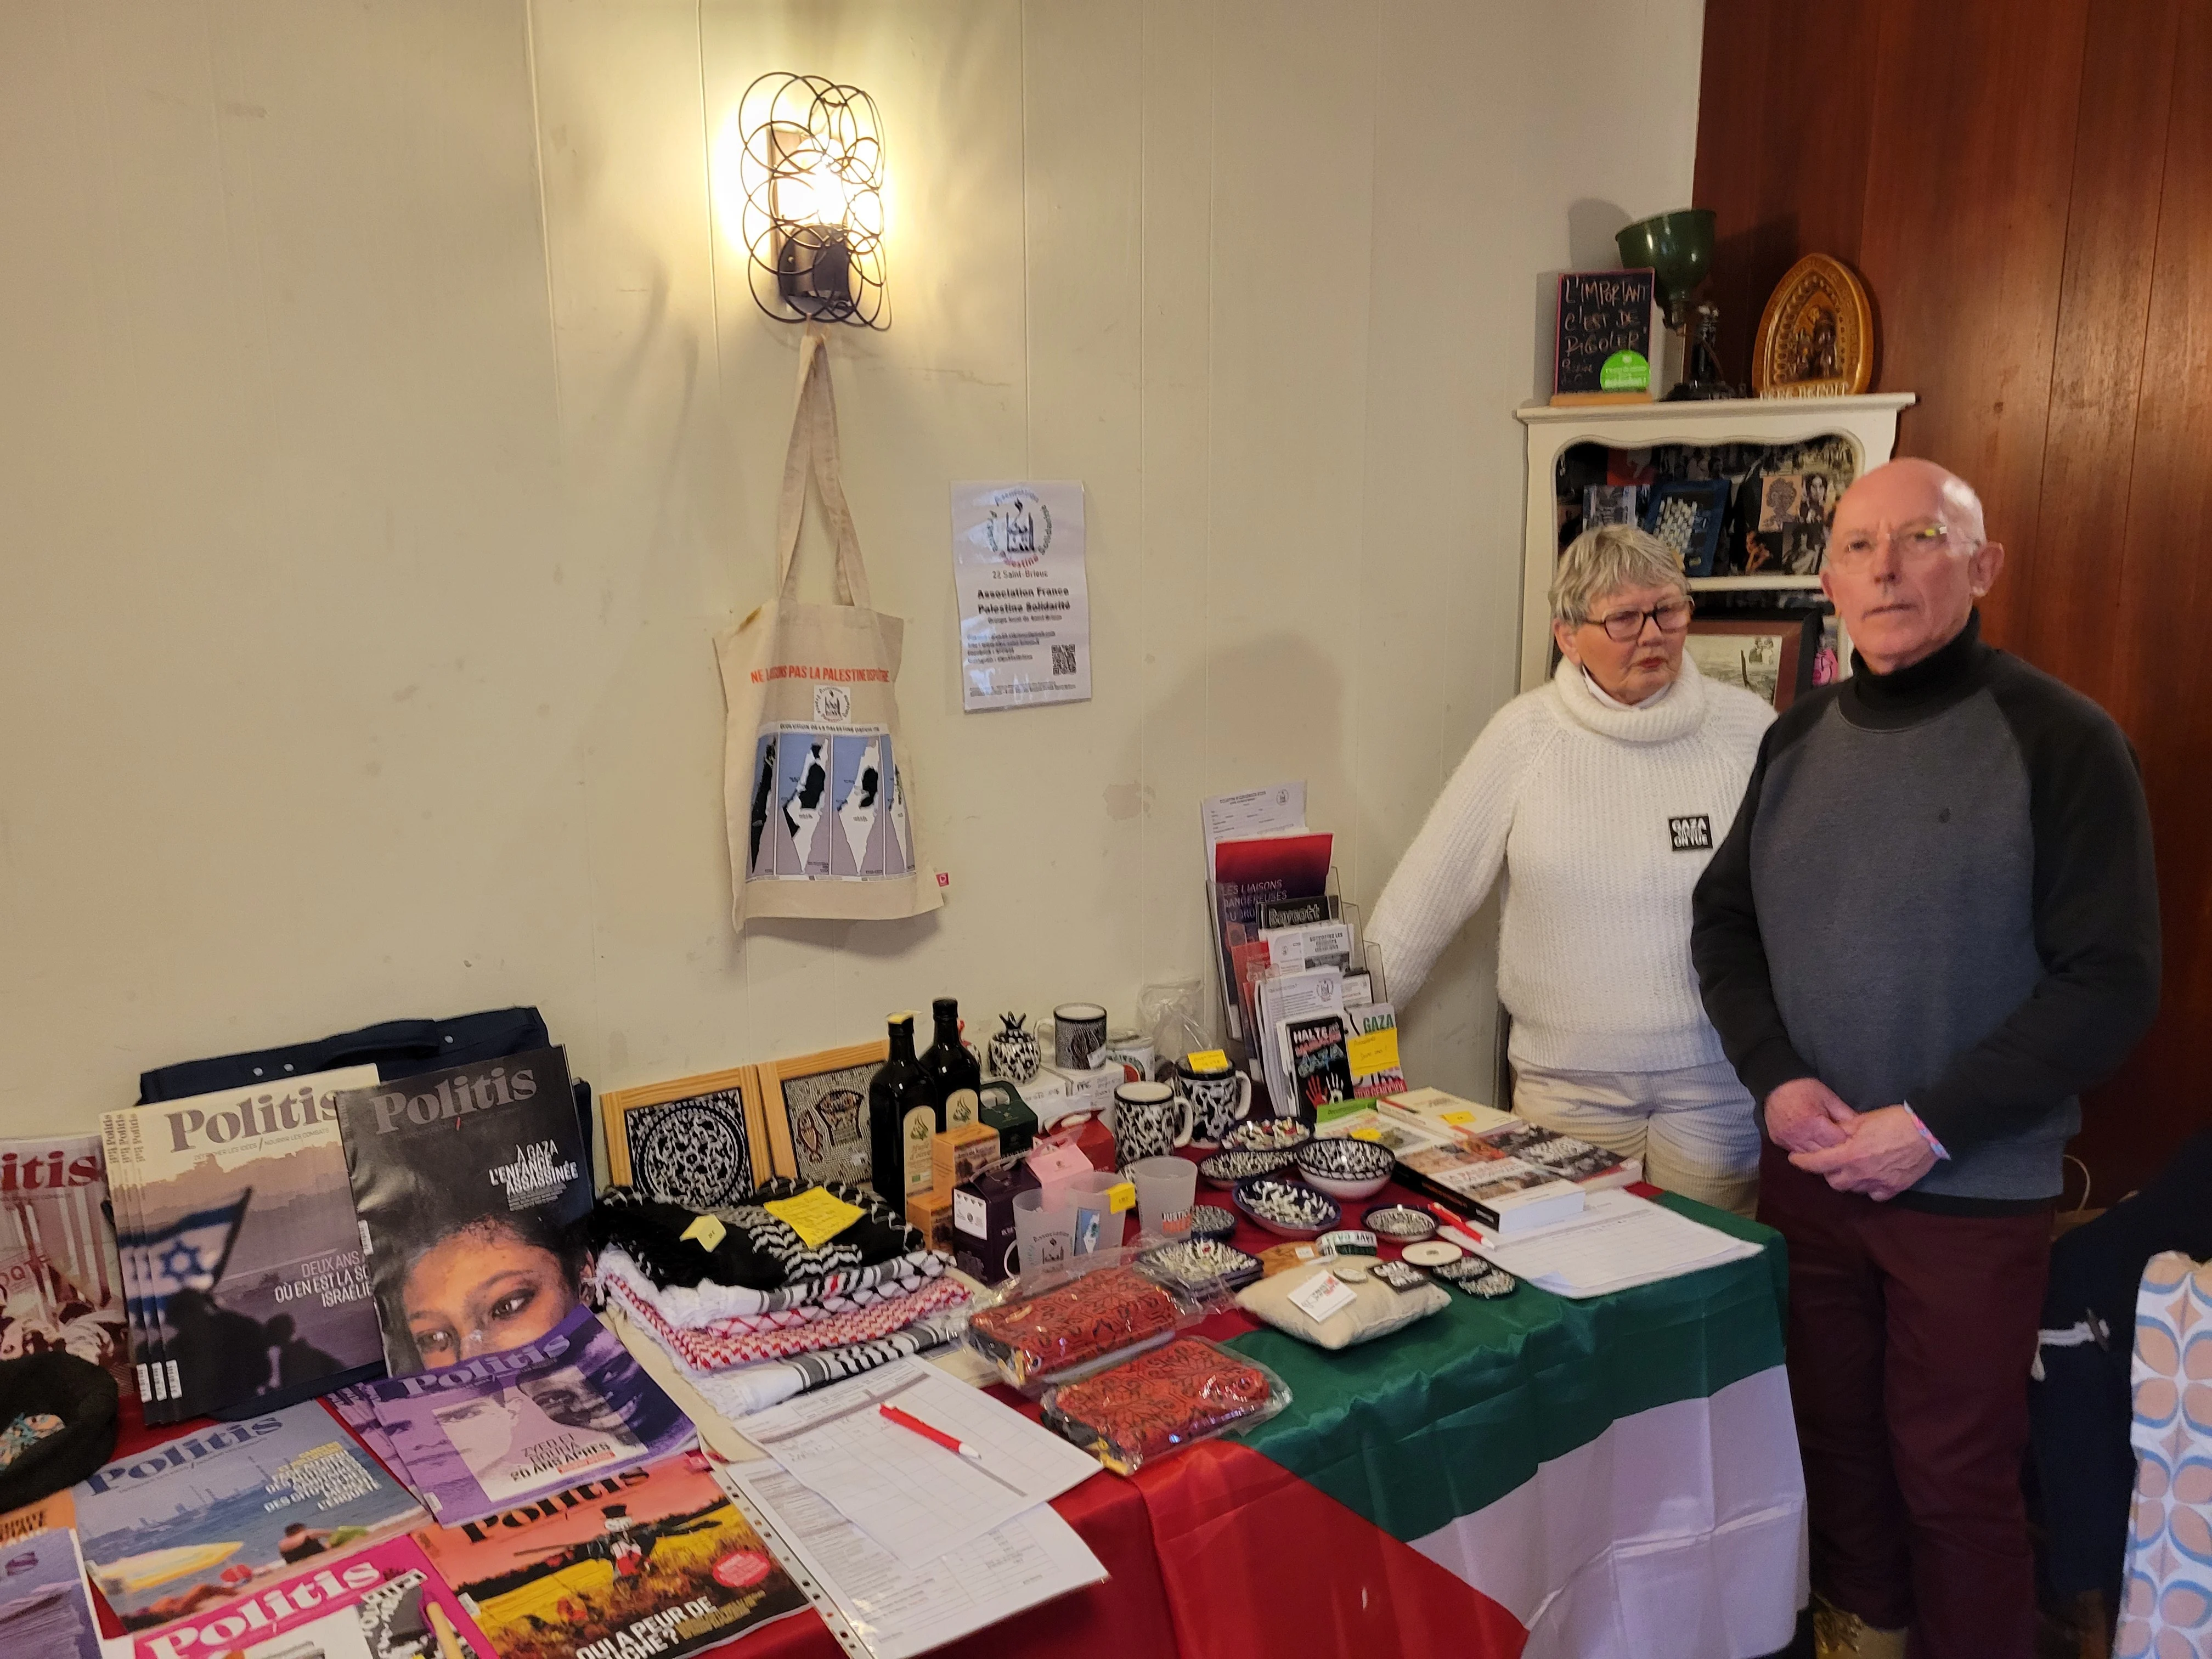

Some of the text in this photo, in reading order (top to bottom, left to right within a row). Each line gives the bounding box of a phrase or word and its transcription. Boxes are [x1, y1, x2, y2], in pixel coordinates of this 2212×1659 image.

[992, 571, 1001, 579] 22
[978, 586, 1069, 599] Association France
[978, 601, 1070, 614] Palestine Solidarité
[751, 669, 764, 684] NE
[788, 665, 806, 679] PAS
[810, 667, 820, 680] LA
[823, 668, 866, 682] PALESTINE
[1242, 879, 1283, 893] LIAISONS
[1224, 890, 1288, 908] DANGEREUSES
[1268, 904, 1320, 929] Boycott
[1293, 1026, 1329, 1043] HALTE
[1363, 1014, 1394, 1034] GAZA
[369, 1067, 537, 1135] Politis
[164, 1086, 337, 1153] Politis
[302, 1127, 330, 1138] COMBATS
[516, 1138, 559, 1164] À GAZA
[506, 1160, 579, 1198] ASSASSINÉE
[301, 1251, 360, 1278] DEUX ANS
[275, 1282, 293, 1304] OÙ
[294, 1280, 312, 1299] EN
[312, 1272, 334, 1294] EST
[336, 1269, 354, 1288] LA
[398, 1334, 571, 1395] Politis
[86, 1417, 283, 1496] Politis
[521, 1432, 574, 1458] ZYED ET
[530, 1442, 580, 1464] BOUNA
[510, 1468, 531, 1482] 20
[533, 1457, 563, 1475] ANS
[461, 1466, 650, 1544] Politis
[145, 1562, 381, 1659] Politis
[616, 1630, 635, 1650] A
[629, 1606, 689, 1645] PEUR
[684, 1595, 719, 1619] DE
[663, 1622, 679, 1645] ?
